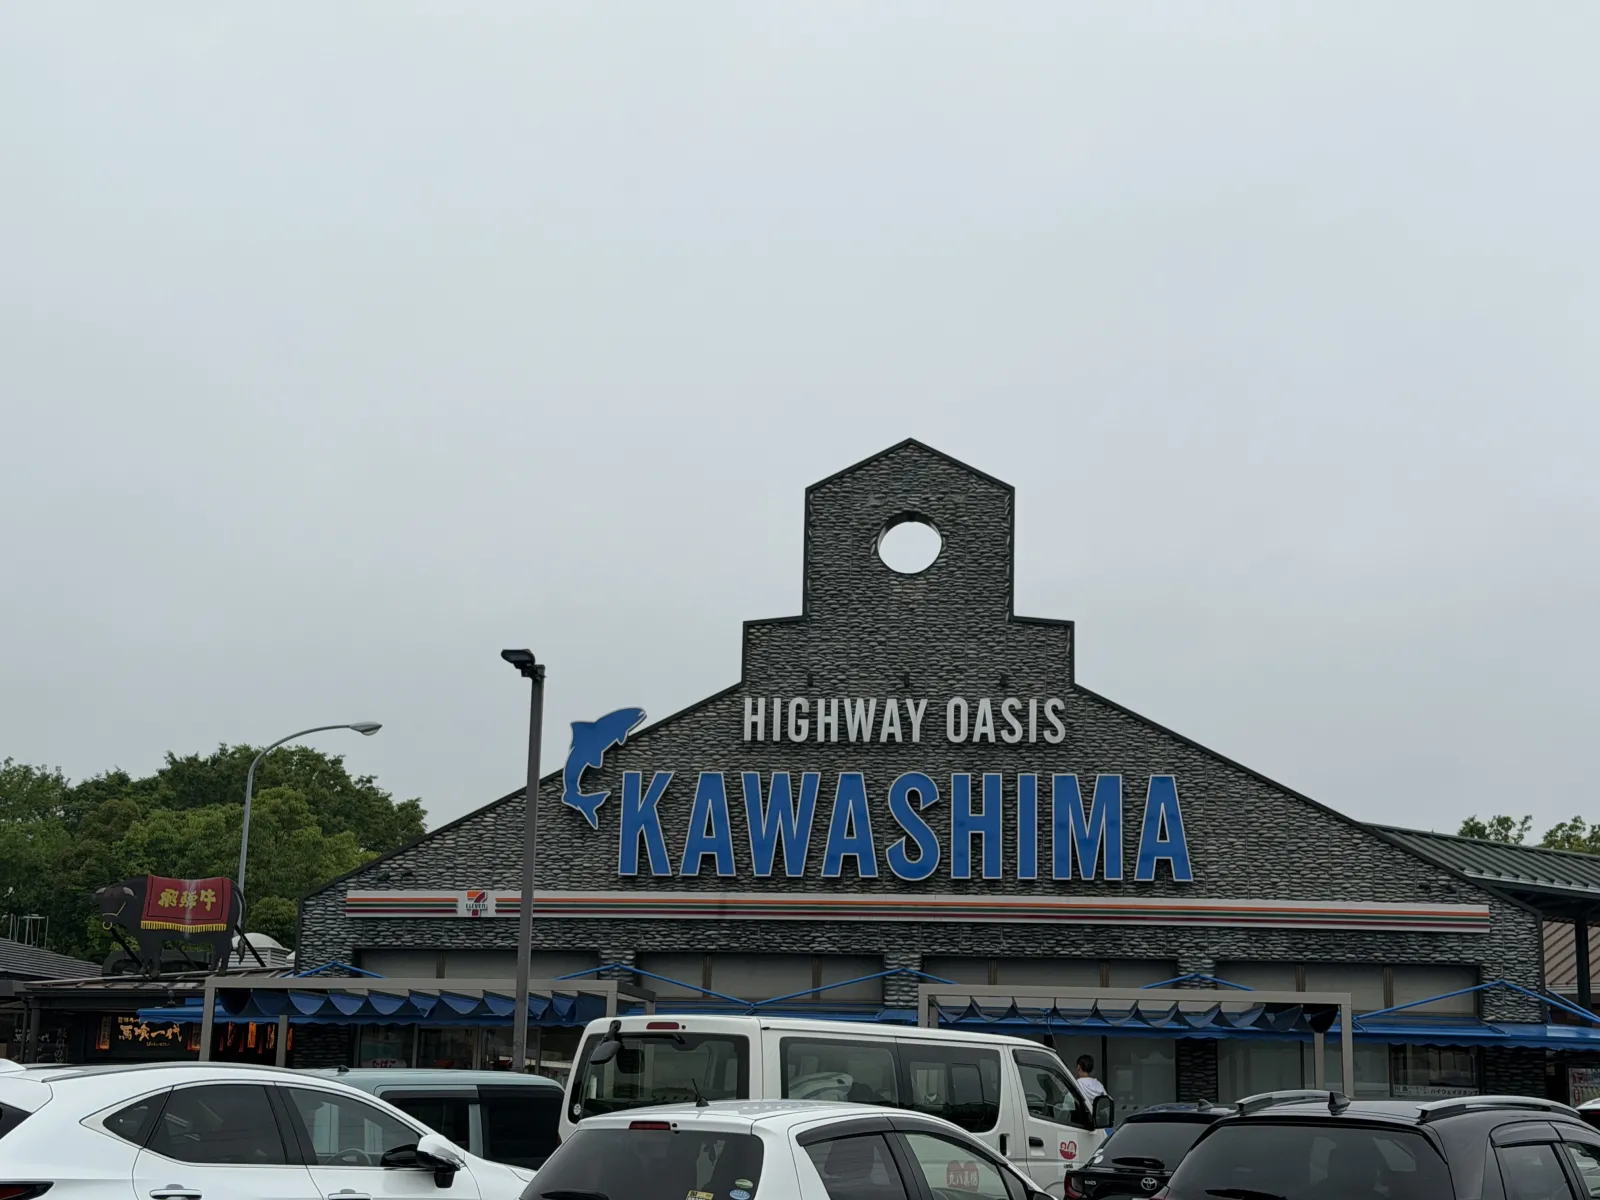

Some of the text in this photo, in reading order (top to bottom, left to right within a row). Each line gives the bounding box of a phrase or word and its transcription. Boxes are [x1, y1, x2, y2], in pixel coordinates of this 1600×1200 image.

[742, 697, 1067, 744] HIGHWAY OASIS
[617, 769, 1194, 883] KAWASHIMA
[117, 1023, 183, 1043] 馬喰一代
